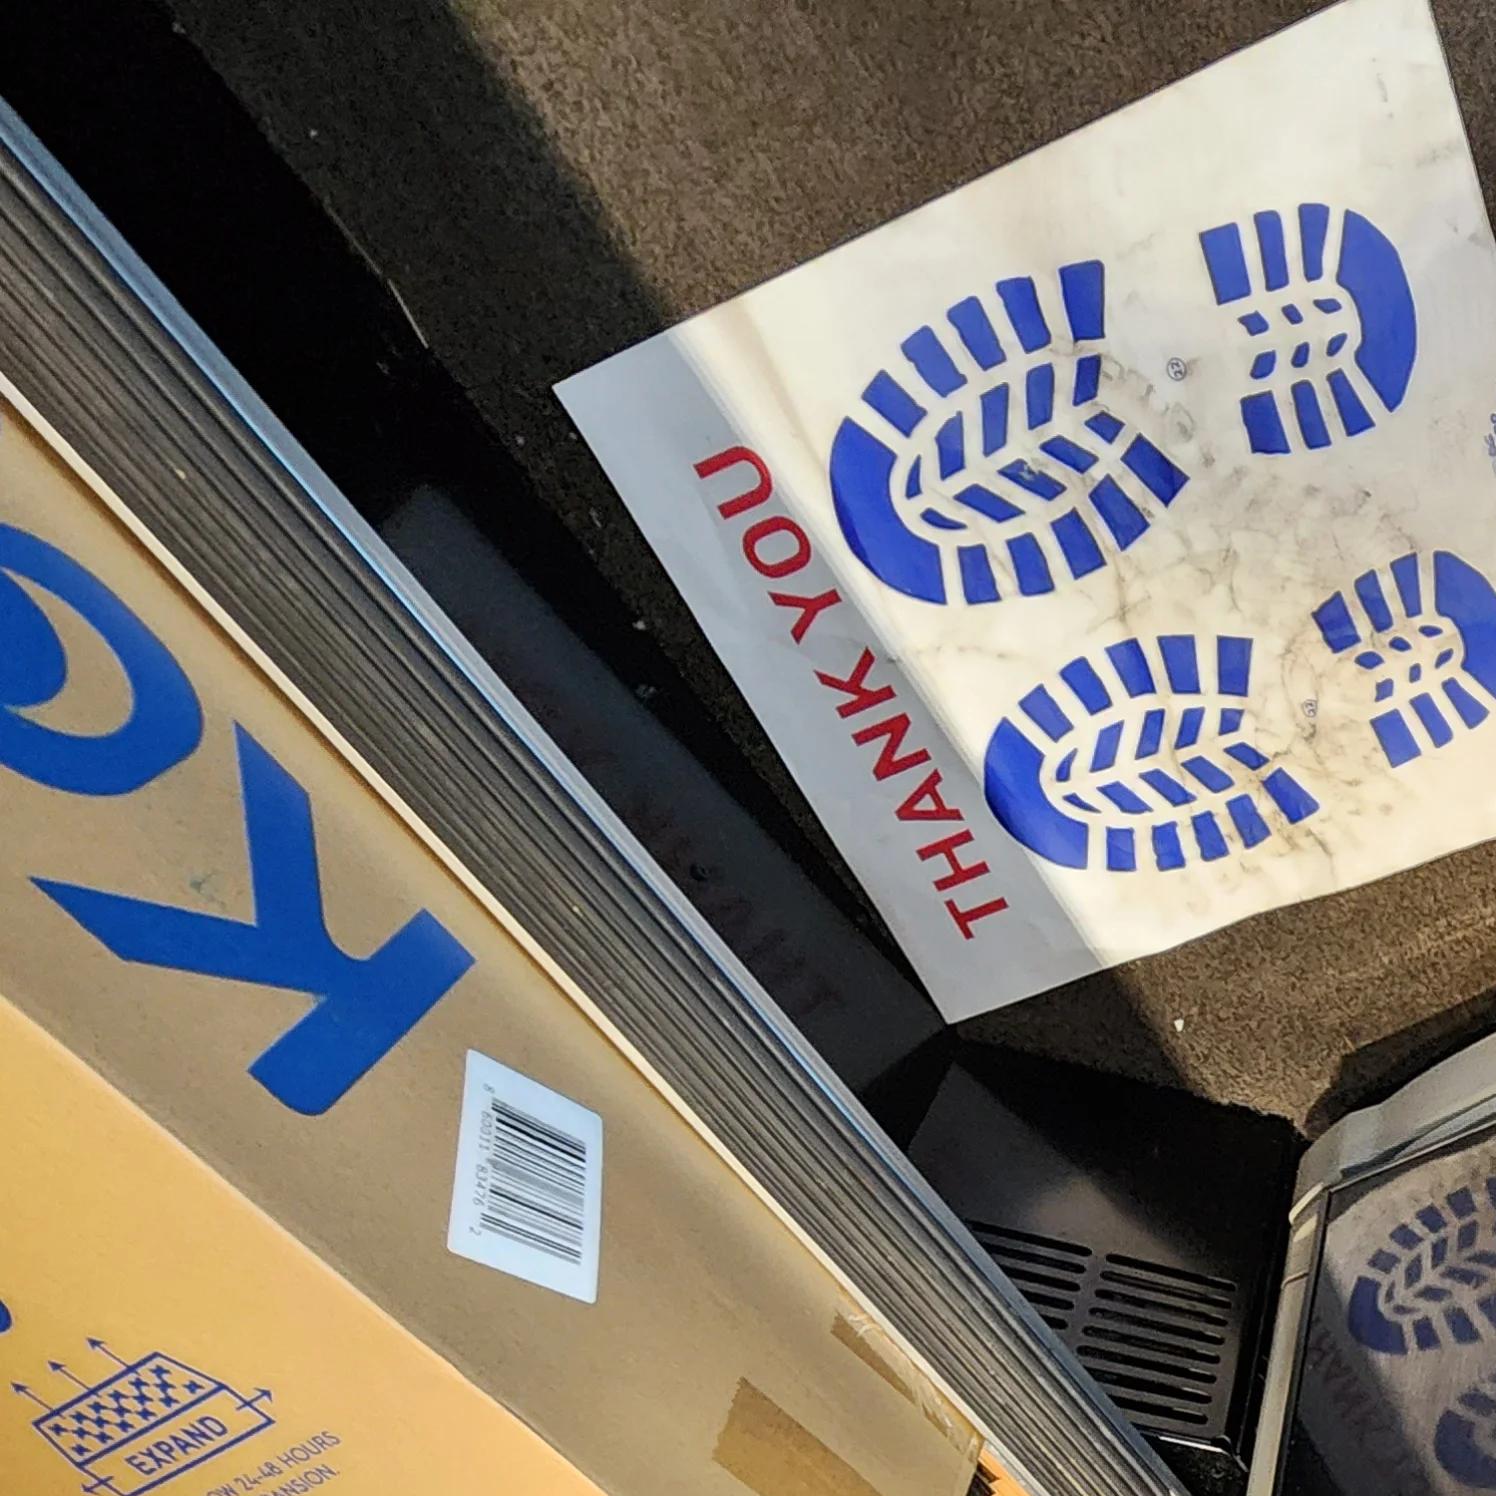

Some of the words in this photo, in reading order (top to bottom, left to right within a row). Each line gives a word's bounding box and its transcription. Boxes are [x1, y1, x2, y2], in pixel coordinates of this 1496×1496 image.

[693, 445, 842, 645] YOU
[814, 646, 1009, 940] THANK
[478, 1110, 493, 1151] 60011
[472, 1164, 488, 1206] 83476
[124, 1416, 228, 1475] EXPAND
[234, 1461, 283, 1491] 24-48
[277, 1431, 341, 1468] HOURS
